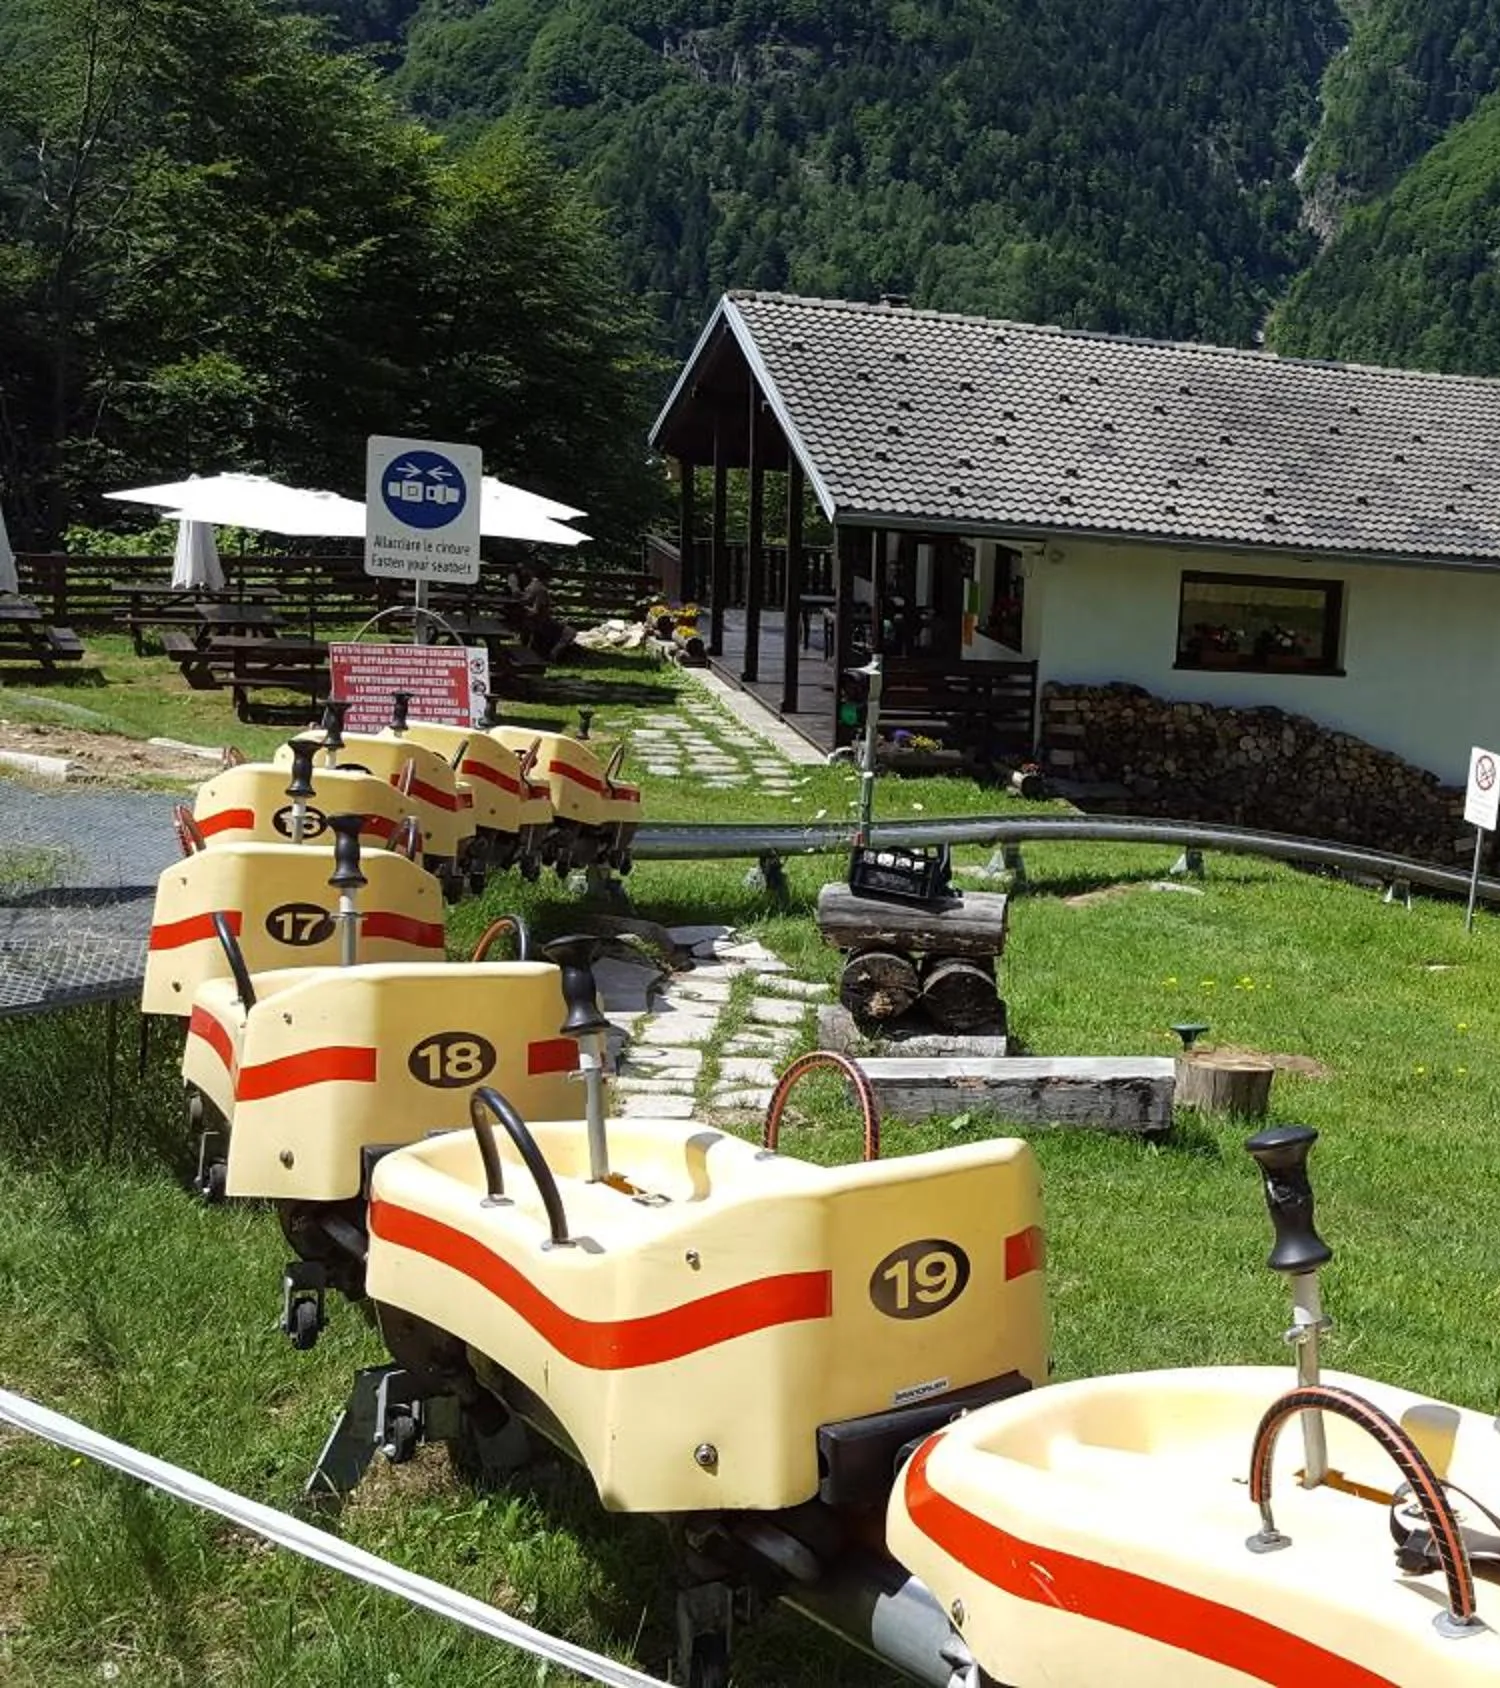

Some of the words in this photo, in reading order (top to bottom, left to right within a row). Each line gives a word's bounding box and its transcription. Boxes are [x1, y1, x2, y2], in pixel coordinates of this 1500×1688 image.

[423, 537, 433, 553] le
[435, 539, 471, 556] cinture
[371, 553, 405, 569] Fasten
[407, 557, 429, 572] your
[431, 560, 472, 575] seatbelt
[275, 911, 325, 940] 17
[418, 1041, 483, 1080] 18
[883, 1251, 958, 1309] 19
